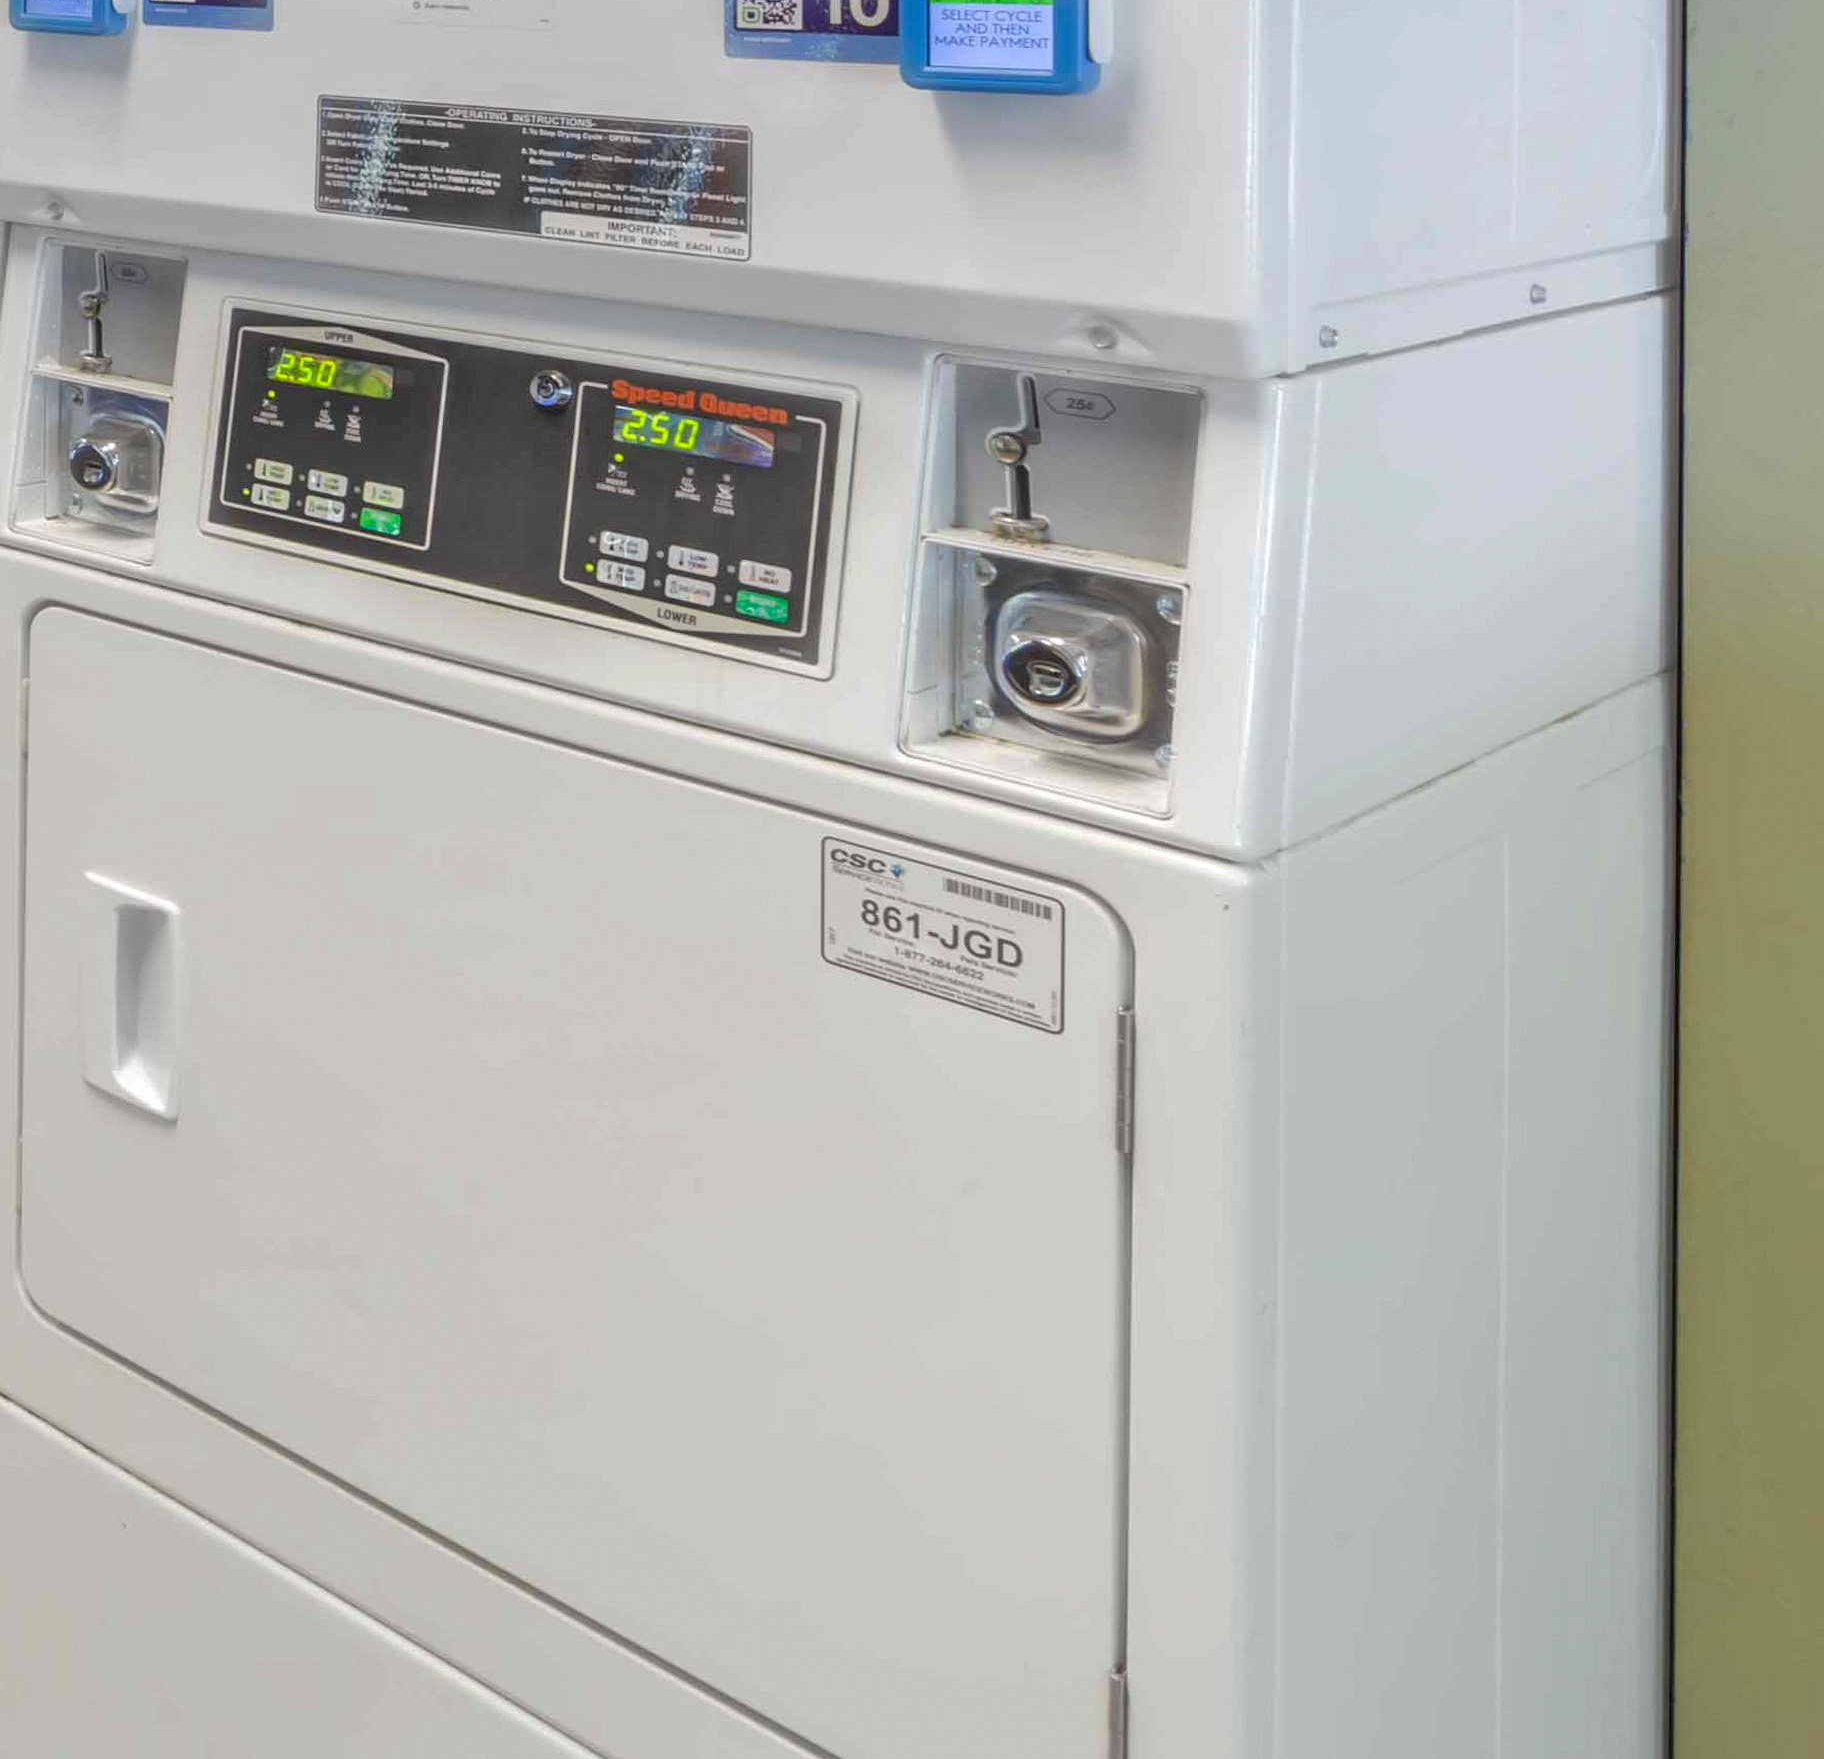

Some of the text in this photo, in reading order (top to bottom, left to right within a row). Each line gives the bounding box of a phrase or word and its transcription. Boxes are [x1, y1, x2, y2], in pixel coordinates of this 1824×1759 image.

[941, 9, 1043, 23] SELECT CYCLE
[954, 23, 1030, 35] AND THEN
[935, 36, 1050, 49] MAKE PAYMENT
[447, 108, 593, 128] OPERATING INSTRUCTIONS
[545, 226, 745, 257] CLEAN LINT FILTER BEFORE EACH LOAD
[324, 330, 354, 343] UPPER
[274, 353, 337, 388] 2.50
[611, 378, 788, 425] Speed Queen
[622, 410, 700, 450] 2.50
[656, 607, 697, 626] LOWER
[830, 848, 887, 873] CSC
[861, 899, 1023, 968] 861-JGD
